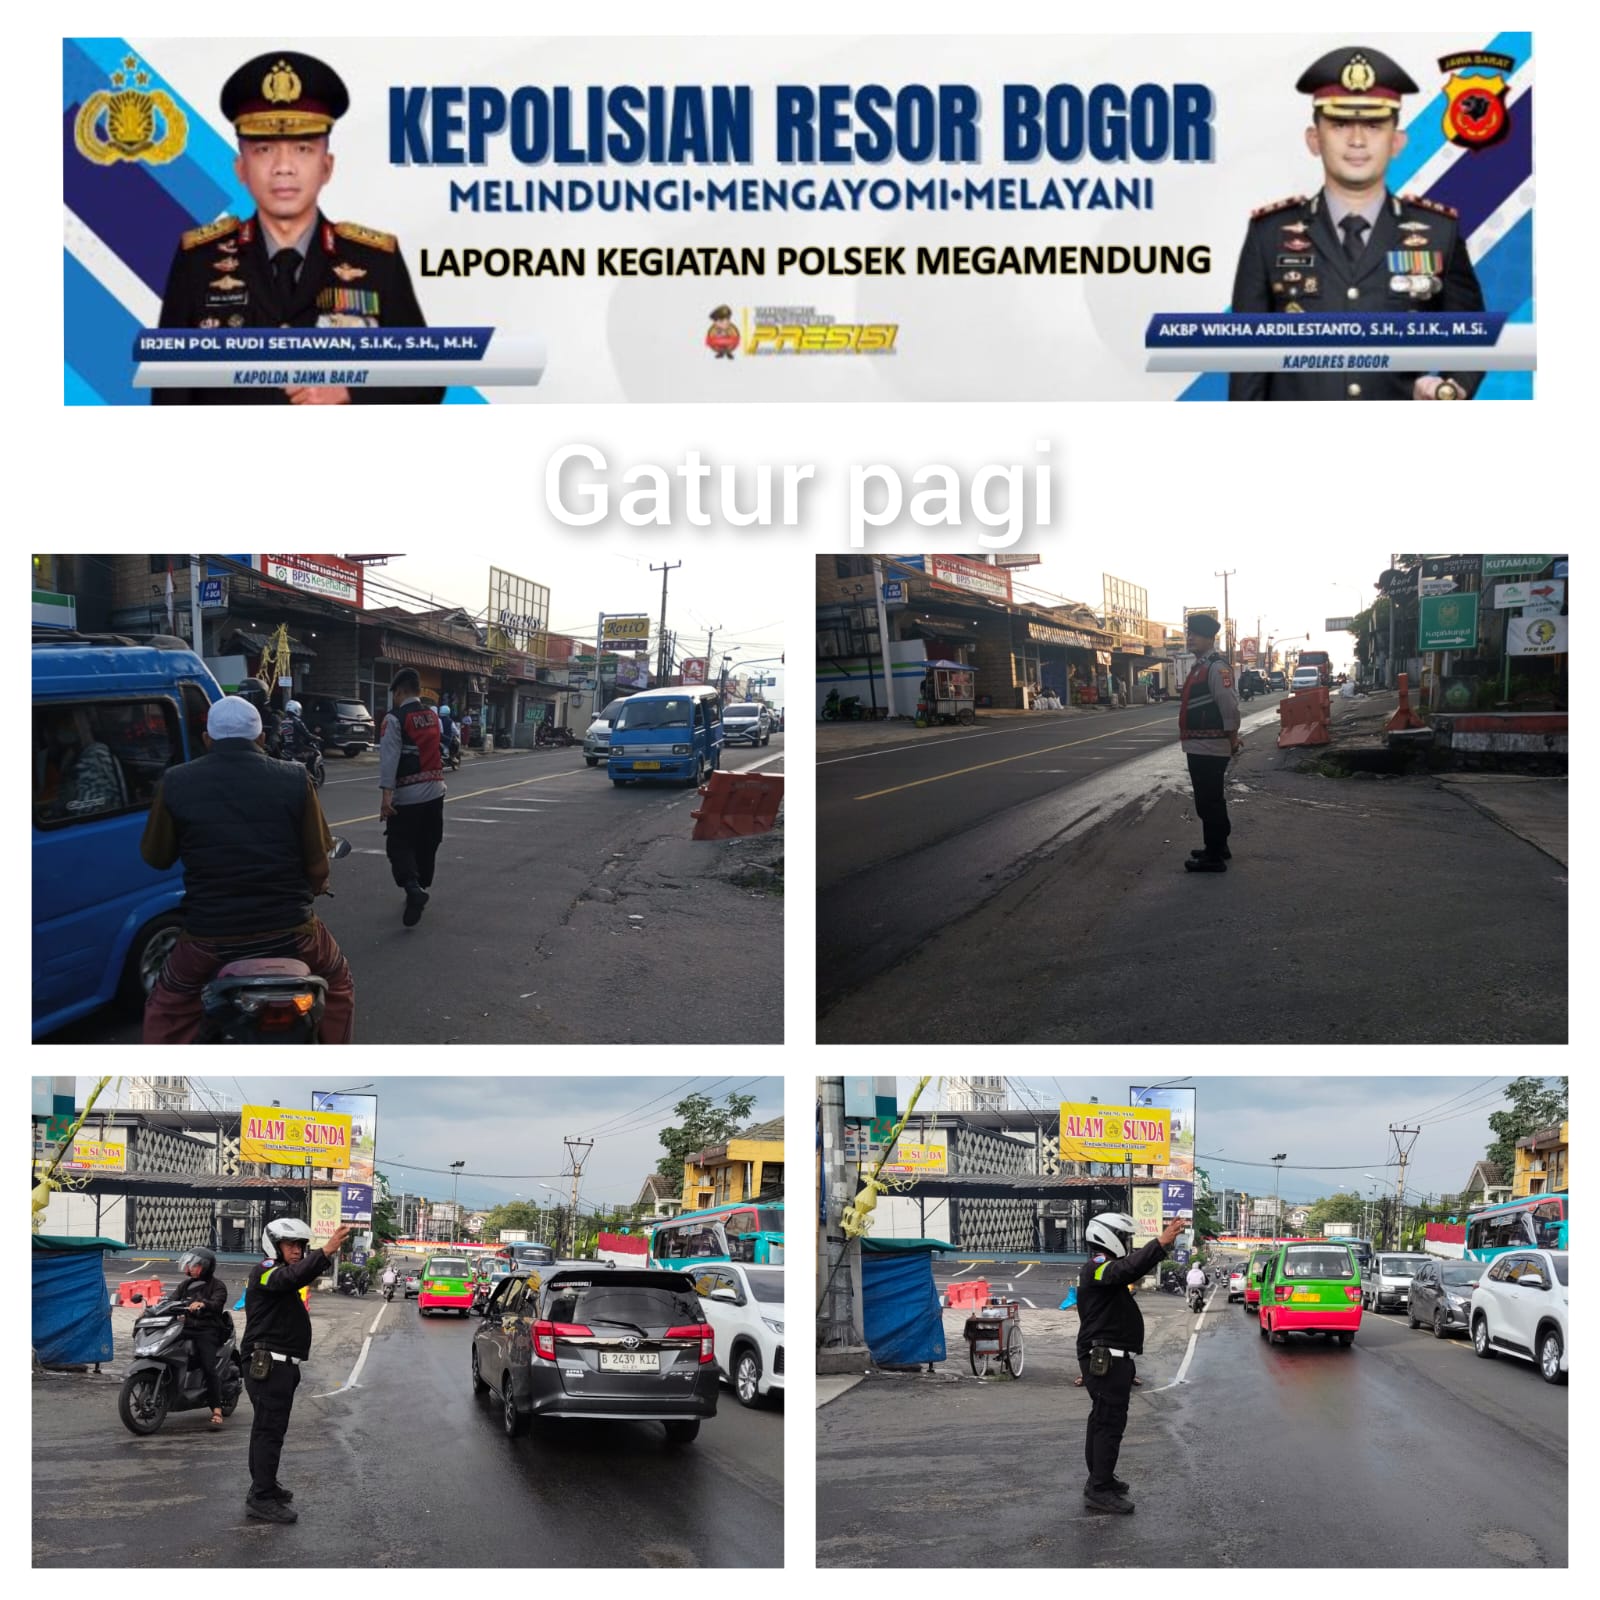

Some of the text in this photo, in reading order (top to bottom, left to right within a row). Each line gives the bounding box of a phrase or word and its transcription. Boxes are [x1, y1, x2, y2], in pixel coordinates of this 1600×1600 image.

[388, 82, 1214, 165] KEPOLISIAN RESOR BOGOR
[420, 245, 1212, 277] LAPORAN KEGIATAN POLSEK MEGAMENDUNG
[1159, 322, 1488, 337] AKBP WIKHA ARDILESTANTO, S.H., S.I.K., M.Si.
[140, 336, 478, 350] IRJEN POL RUDI SETIAWAN, S.I.K., S.H., M.H.
[750, 324, 899, 355] PRESISI
[1282, 355, 1390, 369] KAPOLRES BOGOR
[233, 370, 369, 384] KAPOLDA JAWA BARAT
[1486, 557, 1543, 569] KUTAMARA
[292, 570, 311, 584] BPJS
[311, 575, 351, 593] Kesehatan
[246, 1118, 346, 1146] ALAM SUNDA
[1066, 1116, 1165, 1142] ALAM SUNDA
[602, 1354, 608, 1364] B
